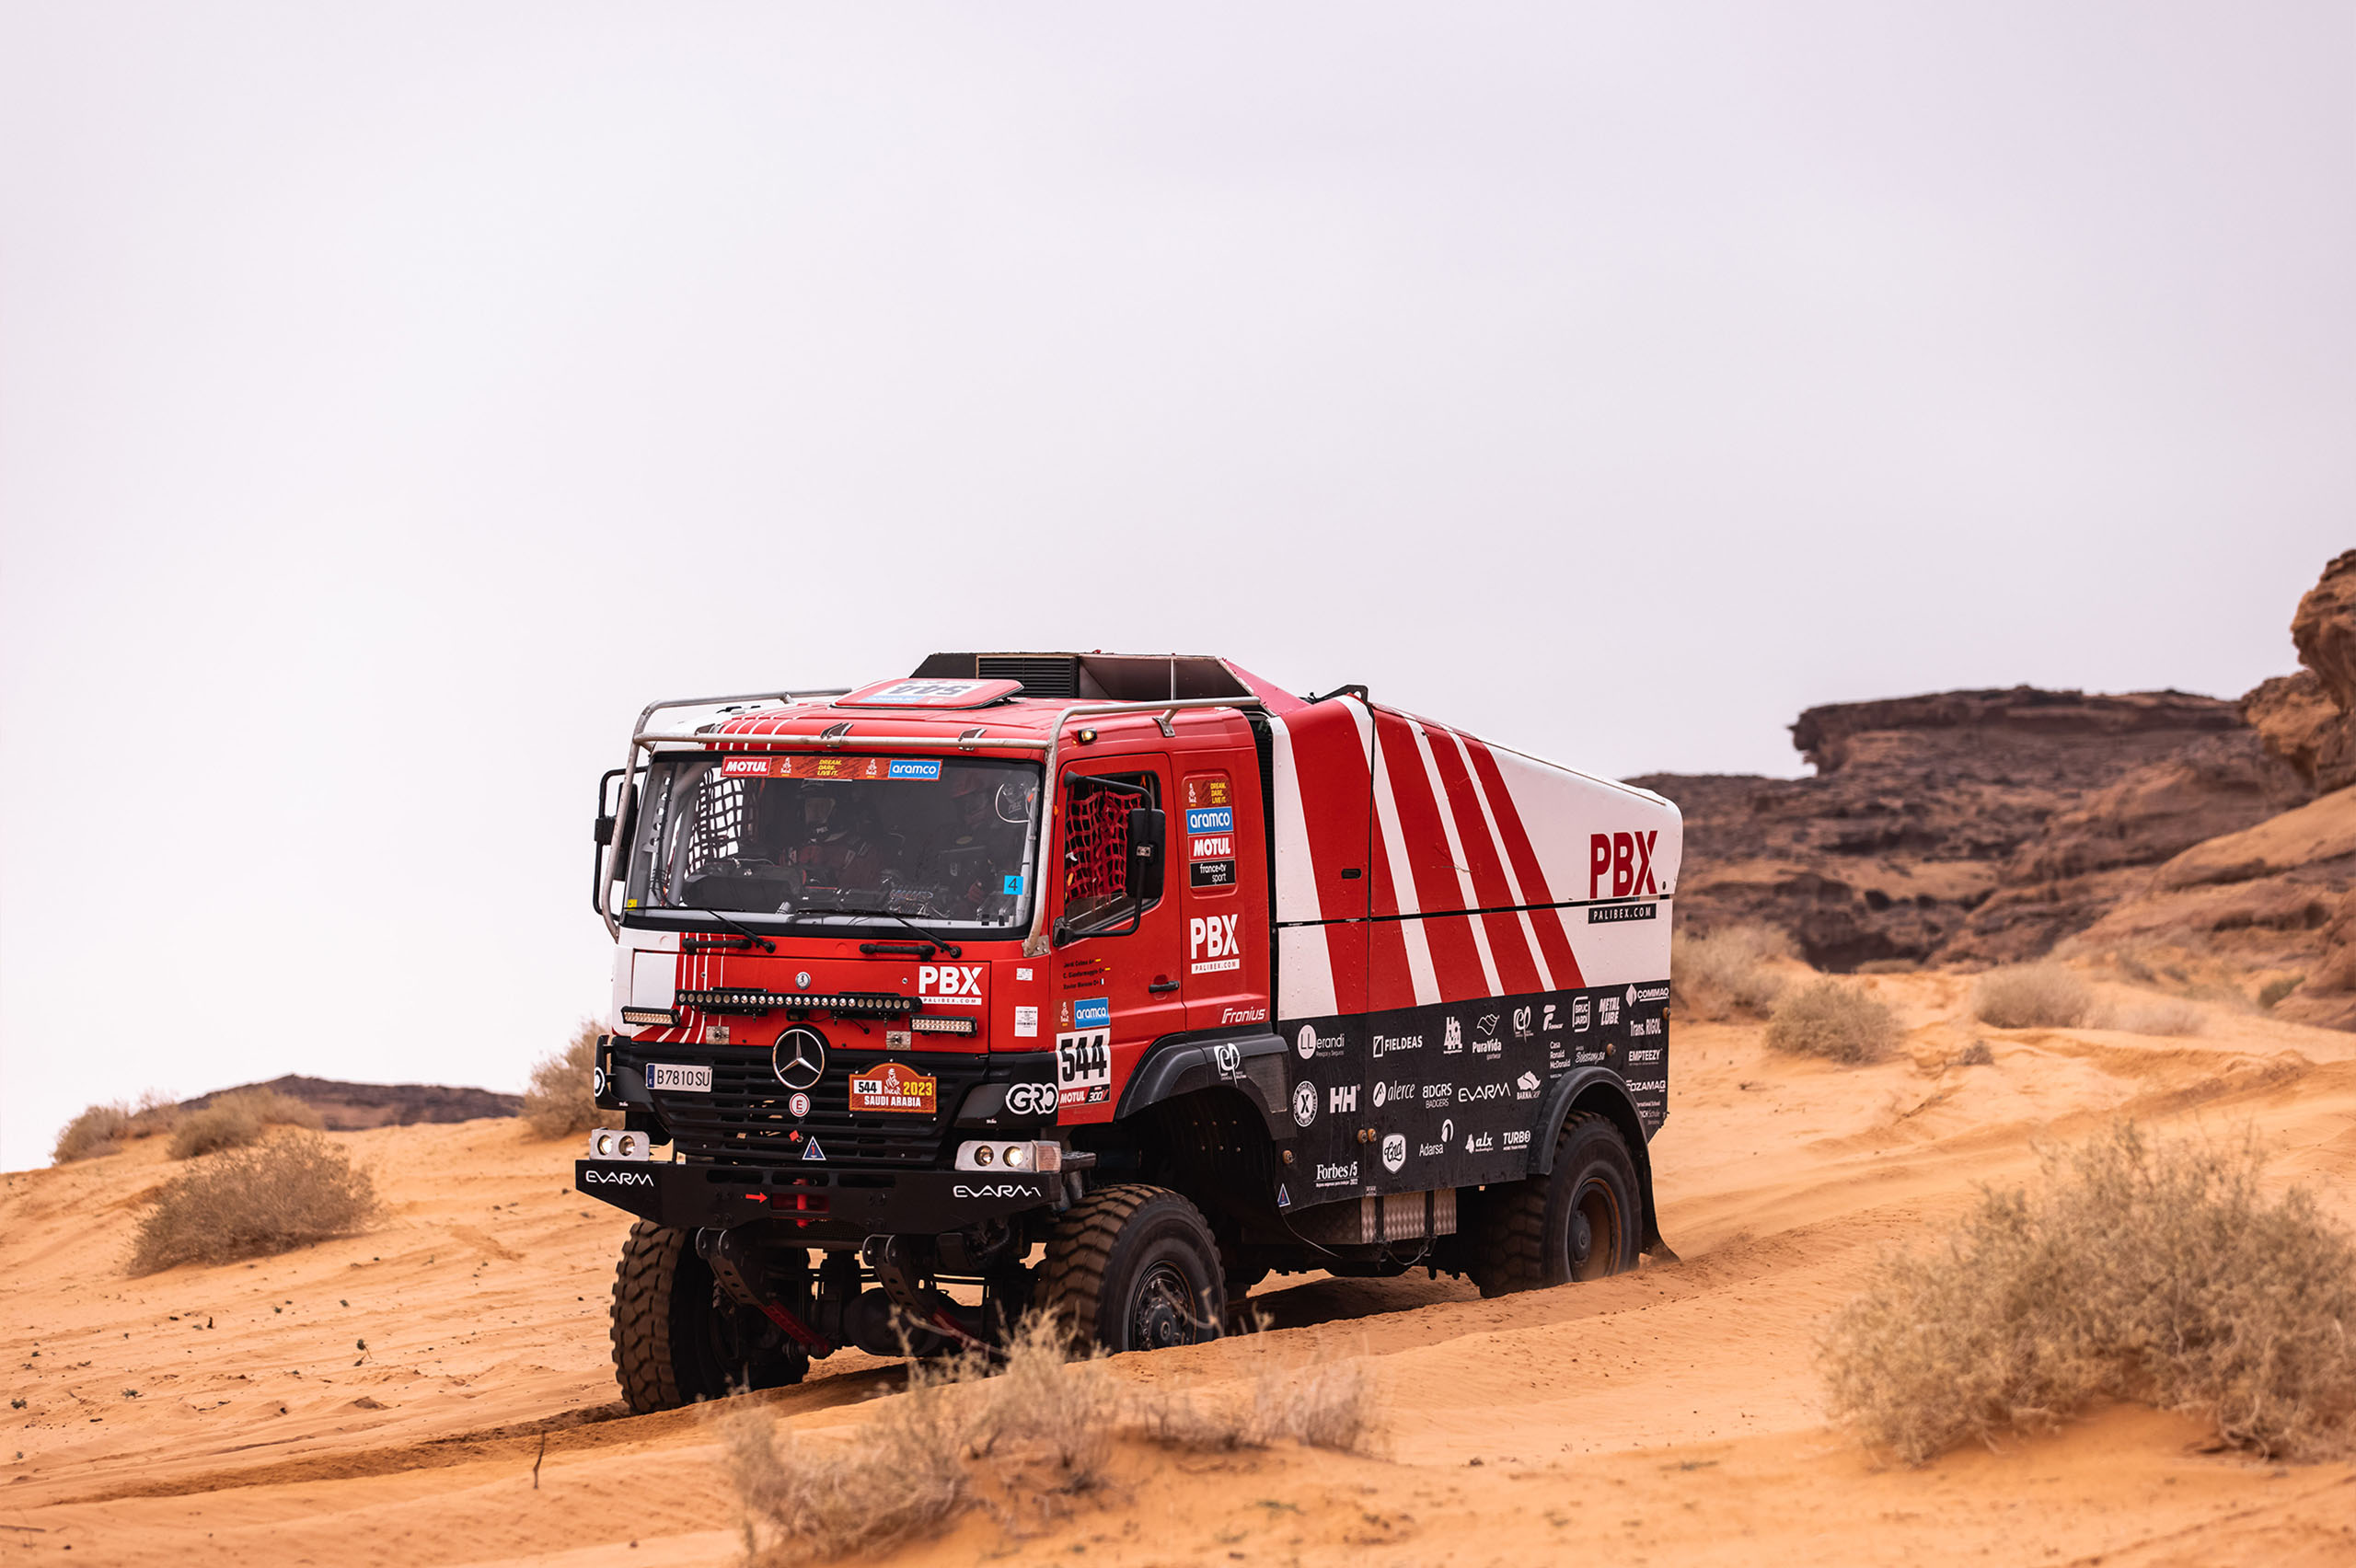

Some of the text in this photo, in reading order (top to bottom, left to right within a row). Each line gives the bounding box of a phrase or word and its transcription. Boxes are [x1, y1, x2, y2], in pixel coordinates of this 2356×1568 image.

[725, 761, 768, 772] MOTUL
[892, 765, 937, 775] aramco
[1190, 812, 1230, 828] aramco
[1193, 837, 1231, 857] MOTUL
[1590, 830, 1657, 899] PBX
[1008, 877, 1018, 892] 4
[1212, 873, 1227, 884] sport
[1593, 906, 1651, 920] PALIBEX.COM
[1190, 914, 1240, 960] PBX
[1195, 960, 1236, 972] PALIBEX.COM
[918, 965, 984, 996] PBX
[1599, 997, 1620, 1012] METAL
[1076, 1007, 1107, 1020] aramco
[1221, 1006, 1266, 1024] Fronius
[1384, 1035, 1423, 1051] FIELDEAS
[1550, 1041, 1561, 1049] Casa
[1059, 1034, 1107, 1083] 544
[1550, 1049, 1565, 1059] Ronald
[1628, 1049, 1660, 1062] EMPTEEZY
[1550, 1058, 1571, 1069] McDonald
[858, 1081, 932, 1096] 544 2023
[1387, 1079, 1415, 1101] alerce
[1458, 1082, 1511, 1102] EVARM
[864, 1095, 921, 1107] SAUDI ARABIA
[1059, 1090, 1085, 1104] MOTUL
[1475, 1131, 1493, 1147] alx
[1418, 1143, 1444, 1157] Adarsa
[585, 1170, 654, 1187] EVARM
[1316, 1162, 1348, 1181] Forbes
